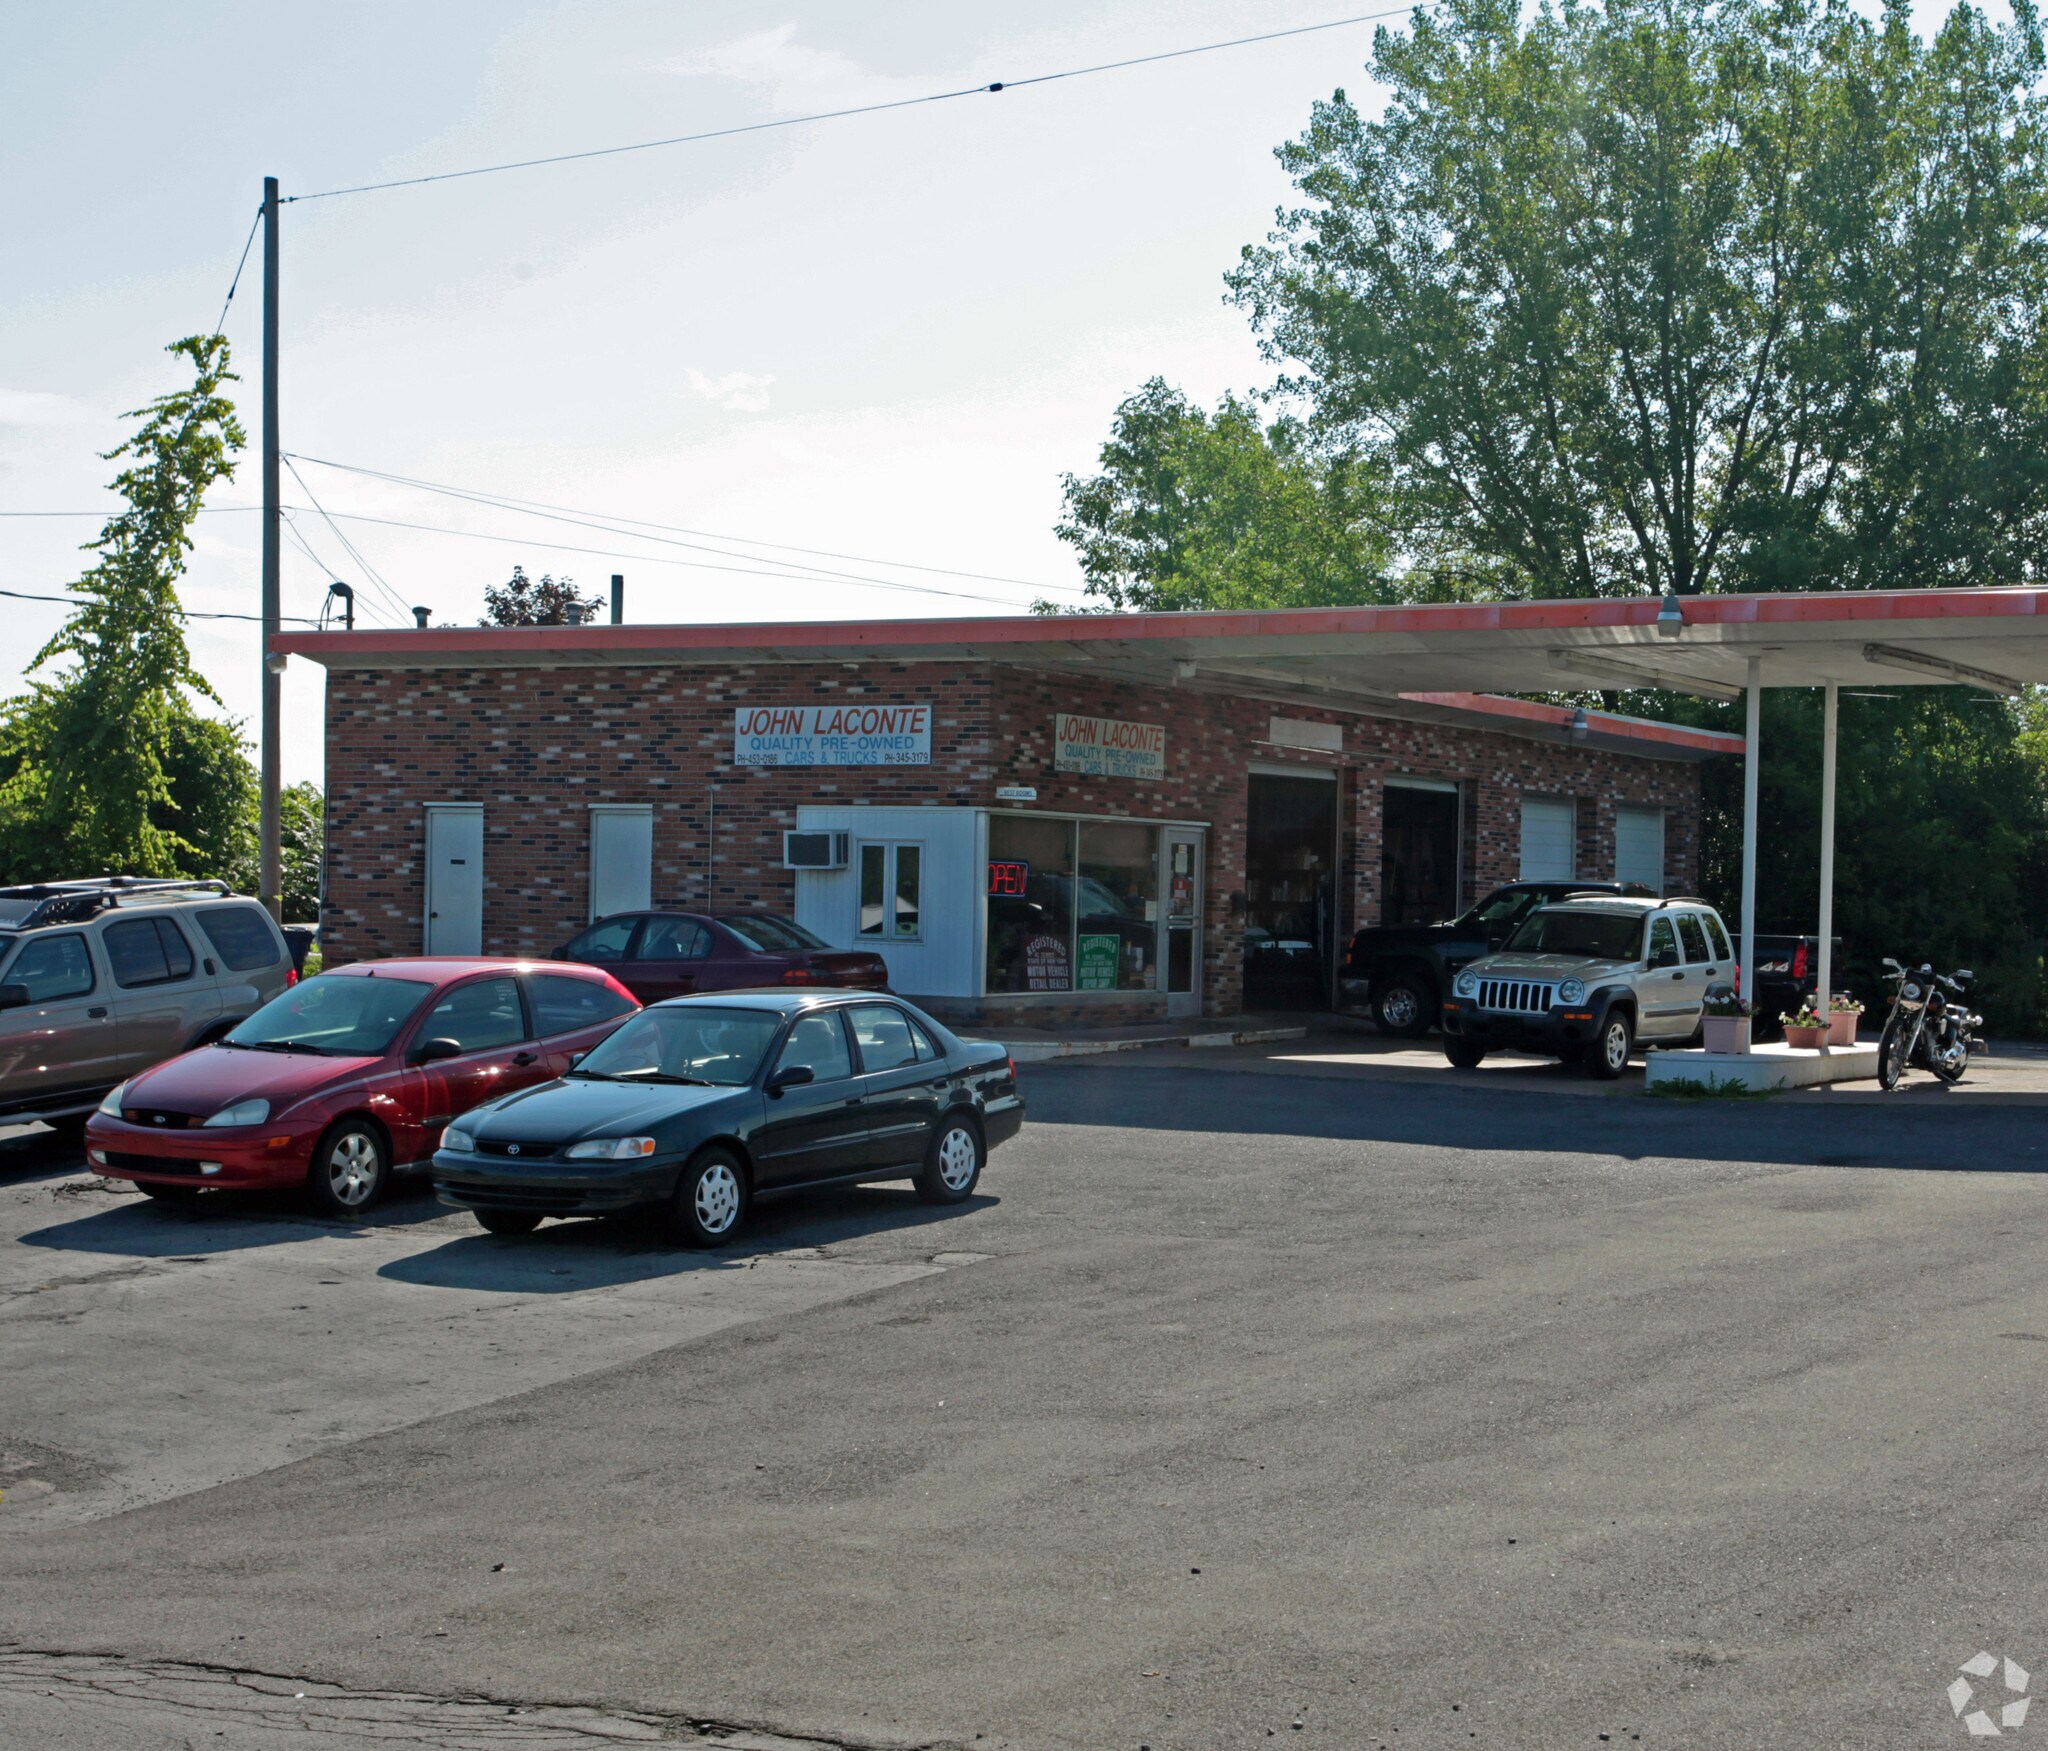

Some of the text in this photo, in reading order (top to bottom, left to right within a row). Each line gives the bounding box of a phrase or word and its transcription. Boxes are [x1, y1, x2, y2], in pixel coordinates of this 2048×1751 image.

[740, 707, 927, 736] JOHN LACONTE
[1059, 717, 1163, 751] JOHN LACONTE
[750, 736, 914, 751] QUALITY PRE-OWNED
[785, 751, 878, 764] CARS & TRUCKS
[1065, 744, 1156, 765] QUALITY PRE-OWNED
[1084, 760, 1102, 774] CARS
[1112, 762, 1137, 777] TRUCKS
[988, 864, 1026, 893] OPEN
[1026, 936, 1067, 956] REGISTERED
[1082, 936, 1116, 953] REGISTERED
[1027, 965, 1069, 977] MOTOR VEHICLE
[1049, 978, 1069, 989] DEALER
